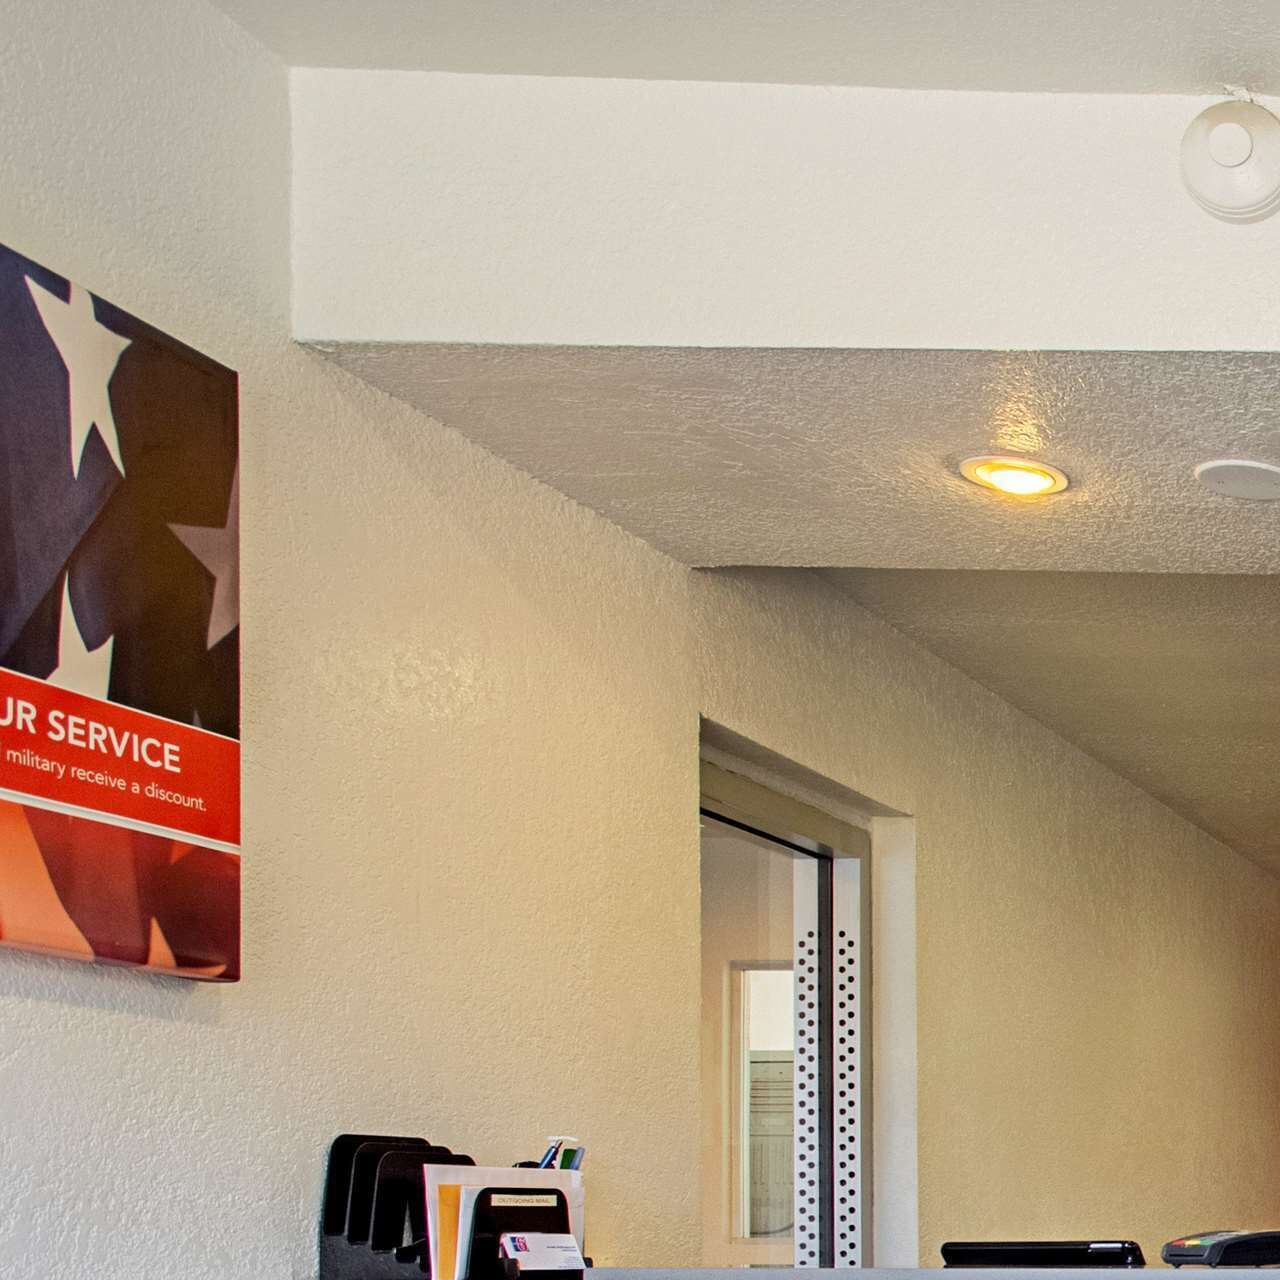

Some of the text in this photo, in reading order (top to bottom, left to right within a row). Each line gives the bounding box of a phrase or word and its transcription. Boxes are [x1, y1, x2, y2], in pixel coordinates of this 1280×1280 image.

[47, 709, 181, 773] SERVICE
[7, 748, 207, 812] military receive a discount.
